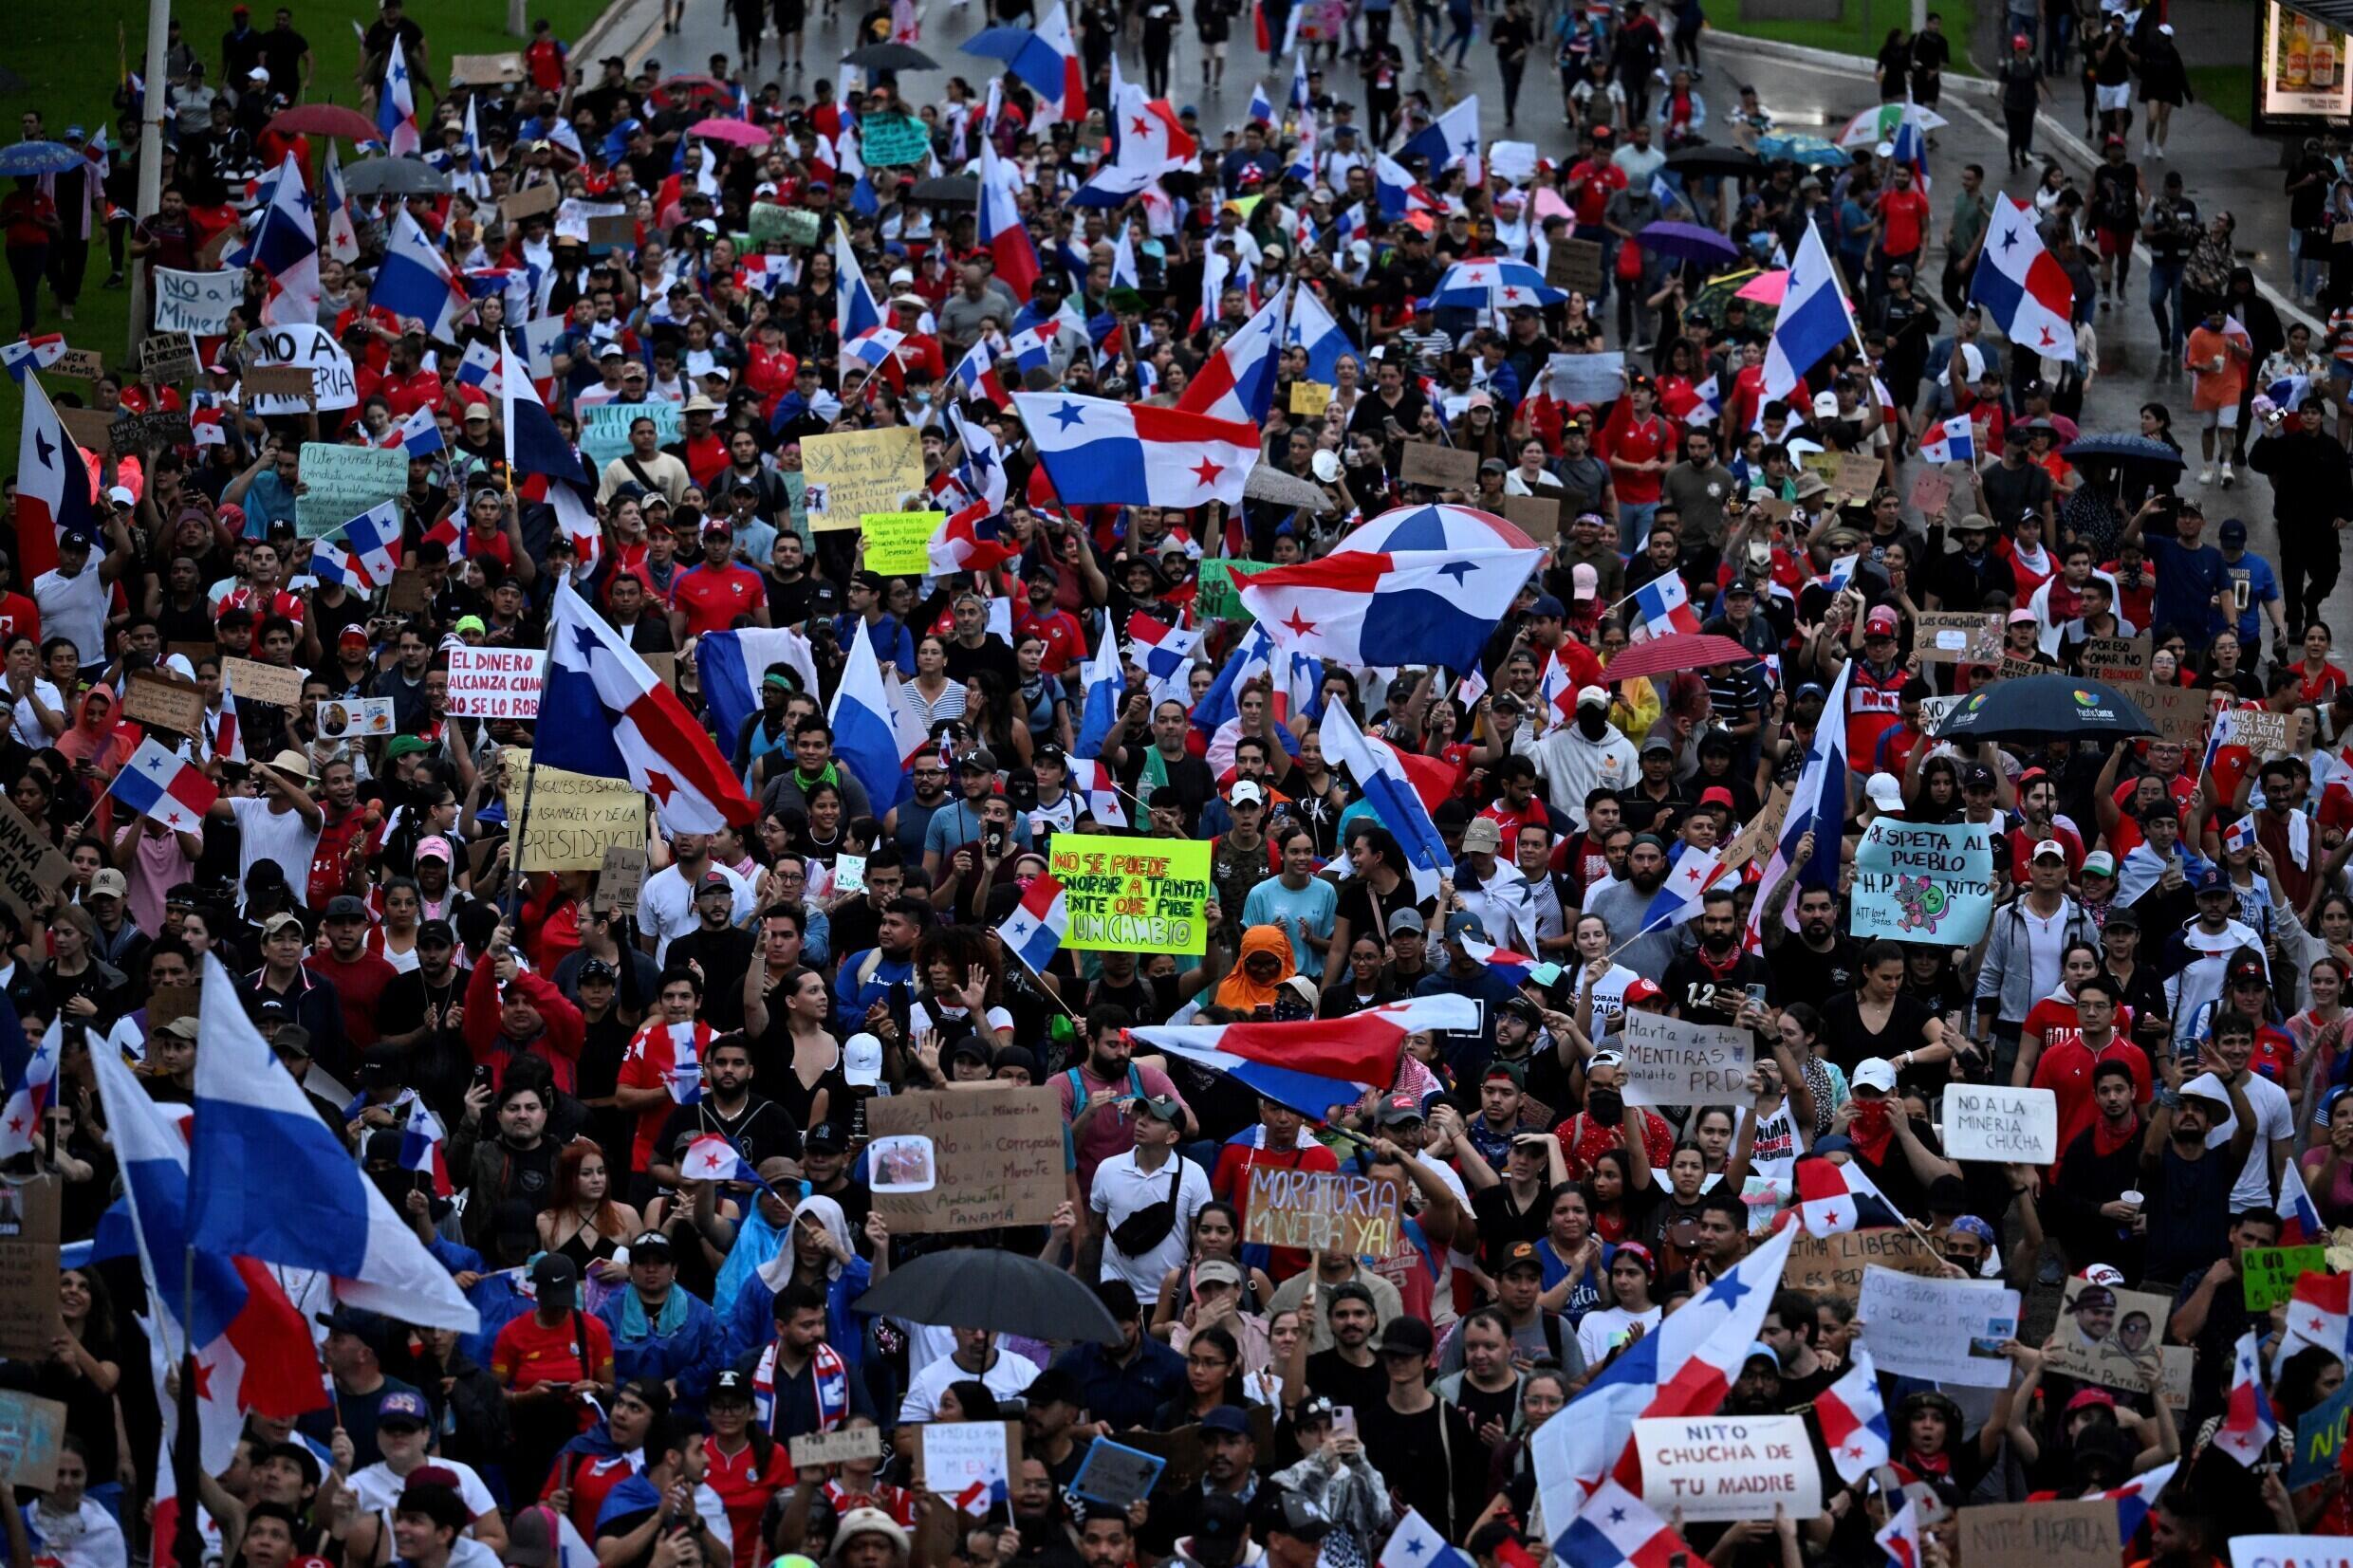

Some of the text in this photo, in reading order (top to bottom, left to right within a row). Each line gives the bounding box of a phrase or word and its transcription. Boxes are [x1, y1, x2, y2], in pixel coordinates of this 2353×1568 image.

[164, 274, 224, 303] NO a
[144, 333, 189, 353] A MI NO
[260, 332, 337, 362] NO A
[64, 352, 88, 363] UCK
[143, 354, 156, 366] ME
[111, 421, 139, 434] UNO
[1202, 581, 1228, 597] NO
[1200, 598, 1222, 617] NI
[1919, 636, 1936, 649] de
[2091, 639, 2130, 654] POR ESO
[452, 652, 533, 672] EL DINERO
[2015, 661, 2030, 674] VEZ
[2089, 652, 2141, 666] OMAR NO
[448, 675, 507, 691] ALCANZA
[2087, 667, 2101, 679] TE
[450, 697, 507, 715] NO SE LO
[1922, 701, 1945, 718] NO
[2163, 695, 2179, 709] NO
[2229, 709, 2287, 727] NITO DE LA
[579, 780, 596, 793] ES
[510, 807, 637, 822] DE ASAMBLEA Y DE LA
[1867, 824, 1989, 851] RESPETA AL
[1052, 851, 1171, 877] NO SE PUEDE
[1891, 850, 1966, 872] PUEBLO
[1126, 876, 1207, 899] A TANTA
[1065, 895, 1195, 917] ENTE QUE PIDE
[1073, 913, 1191, 947] UN CAMBIO
[1628, 1016, 1739, 1044] Harta de tus
[1627, 1045, 1725, 1065] MENTIRAS
[1690, 1068, 1744, 1092] PRD
[929, 1100, 954, 1123] No
[1957, 1095, 2026, 1116] NO A LA
[1957, 1115, 2023, 1134] MINERIA
[935, 1135, 958, 1154] No
[996, 1134, 1062, 1156] Corrupción
[1985, 1134, 2043, 1152] CHUCHA
[936, 1165, 958, 1186] No
[1003, 1159, 1050, 1179] Muerte
[1250, 1167, 1398, 1218] MORATORIA
[949, 1203, 1015, 1224] PANAMÁ
[1245, 1208, 1395, 1258] MINERA YA!
[1805, 1270, 1826, 1287] ES
[2101, 1369, 2148, 1392] PATRIA
[1686, 1424, 1750, 1442] NITO
[1656, 1443, 1794, 1466] CHUCHA DE
[965, 1460, 986, 1475] EX
[1669, 1472, 1797, 1498] TU MADRE
